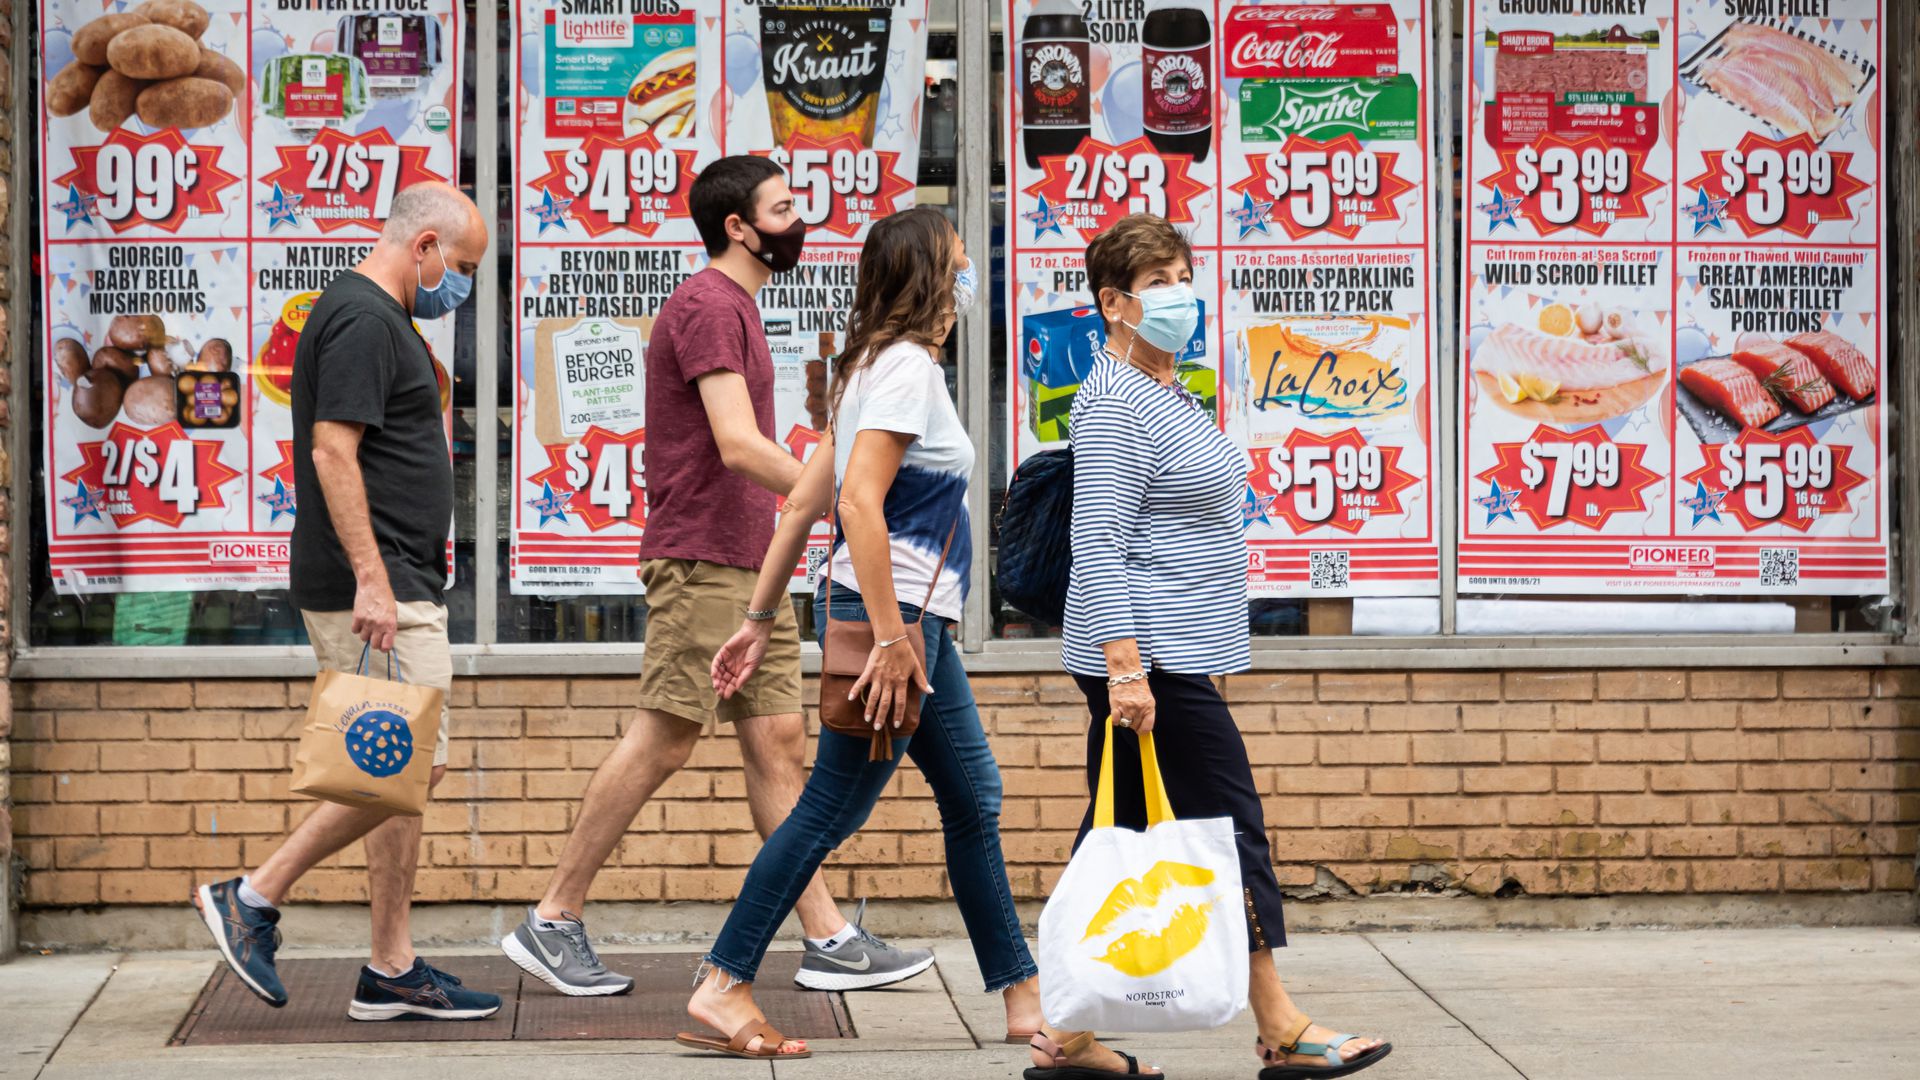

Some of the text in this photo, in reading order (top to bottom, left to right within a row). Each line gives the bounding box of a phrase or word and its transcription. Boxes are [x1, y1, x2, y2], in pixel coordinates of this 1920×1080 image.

[562, 0, 680, 16] SMART DOGS
[1082, 0, 1145, 22] 2 LITER
[1499, 0, 1647, 15] GROUND TURKEY
[1725, 0, 1829, 17] SWAI FILLET
[1090, 22, 1139, 43] SODA
[1502, 35, 1550, 46] SHADY BROOK
[555, 54, 585, 64] Smart
[772, 41, 878, 85] Kraut
[1278, 94, 1363, 130] Sprite
[96, 143, 198, 220] 99¢
[306, 141, 400, 219] 2/$7
[640, 197, 671, 210] 12 oz.
[845, 197, 858, 211] 16
[1337, 199, 1376, 213] 144 oz.
[1590, 197, 1621, 209] 16 oz.
[109, 246, 184, 268] GIORGIO
[561, 250, 682, 272] BEYOND MEAT
[1030, 256, 1042, 269] 12
[1235, 254, 1248, 266] 12
[1267, 253, 1354, 266] Cans-Assorted
[1357, 253, 1411, 266] Varieties
[1487, 249, 1506, 261] Cut
[1509, 249, 1536, 262] from
[1622, 250, 1657, 262] Scrod
[1688, 250, 1727, 263] Frozen
[1729, 253, 1741, 263] or
[1794, 251, 1821, 264] Wild
[1823, 251, 1864, 266] Caught
[94, 269, 199, 291] BABY BELLA
[1231, 267, 1414, 291] LACROIX SPARKLING
[1485, 263, 1658, 286] WILD SCROD FILLET
[1699, 265, 1853, 288] GREAT AMERICAN
[550, 273, 618, 295] BEYOND
[89, 292, 206, 315] MUSHROOMS
[762, 287, 827, 309] ITALIAN
[1252, 290, 1394, 313] WATER 12 PACK
[1710, 288, 1843, 310] SALMON FILLET
[524, 296, 643, 318] PLANT-BASED
[799, 310, 846, 332] LINKS
[1731, 311, 1822, 333] PORTIONS
[574, 335, 620, 346] BEYOND MEAT
[566, 348, 633, 369] BEYOND
[567, 363, 635, 384] BURGER
[572, 384, 634, 398] PLANT-BASED
[586, 395, 621, 406] PATTIES
[570, 413, 592, 425] 20G
[101, 436, 200, 514] 2/$4
[1340, 494, 1380, 507] 144 oz.
[1794, 491, 1827, 504] 16 oz.
[213, 544, 288, 559] PIONEER
[1633, 548, 1711, 563] PIONEER
[1469, 577, 1487, 585] GOOD
[1489, 577, 1506, 585] UNTIL
[1125, 989, 1184, 1001] NORDSTROM
[1145, 1000, 1166, 1008] beauty
